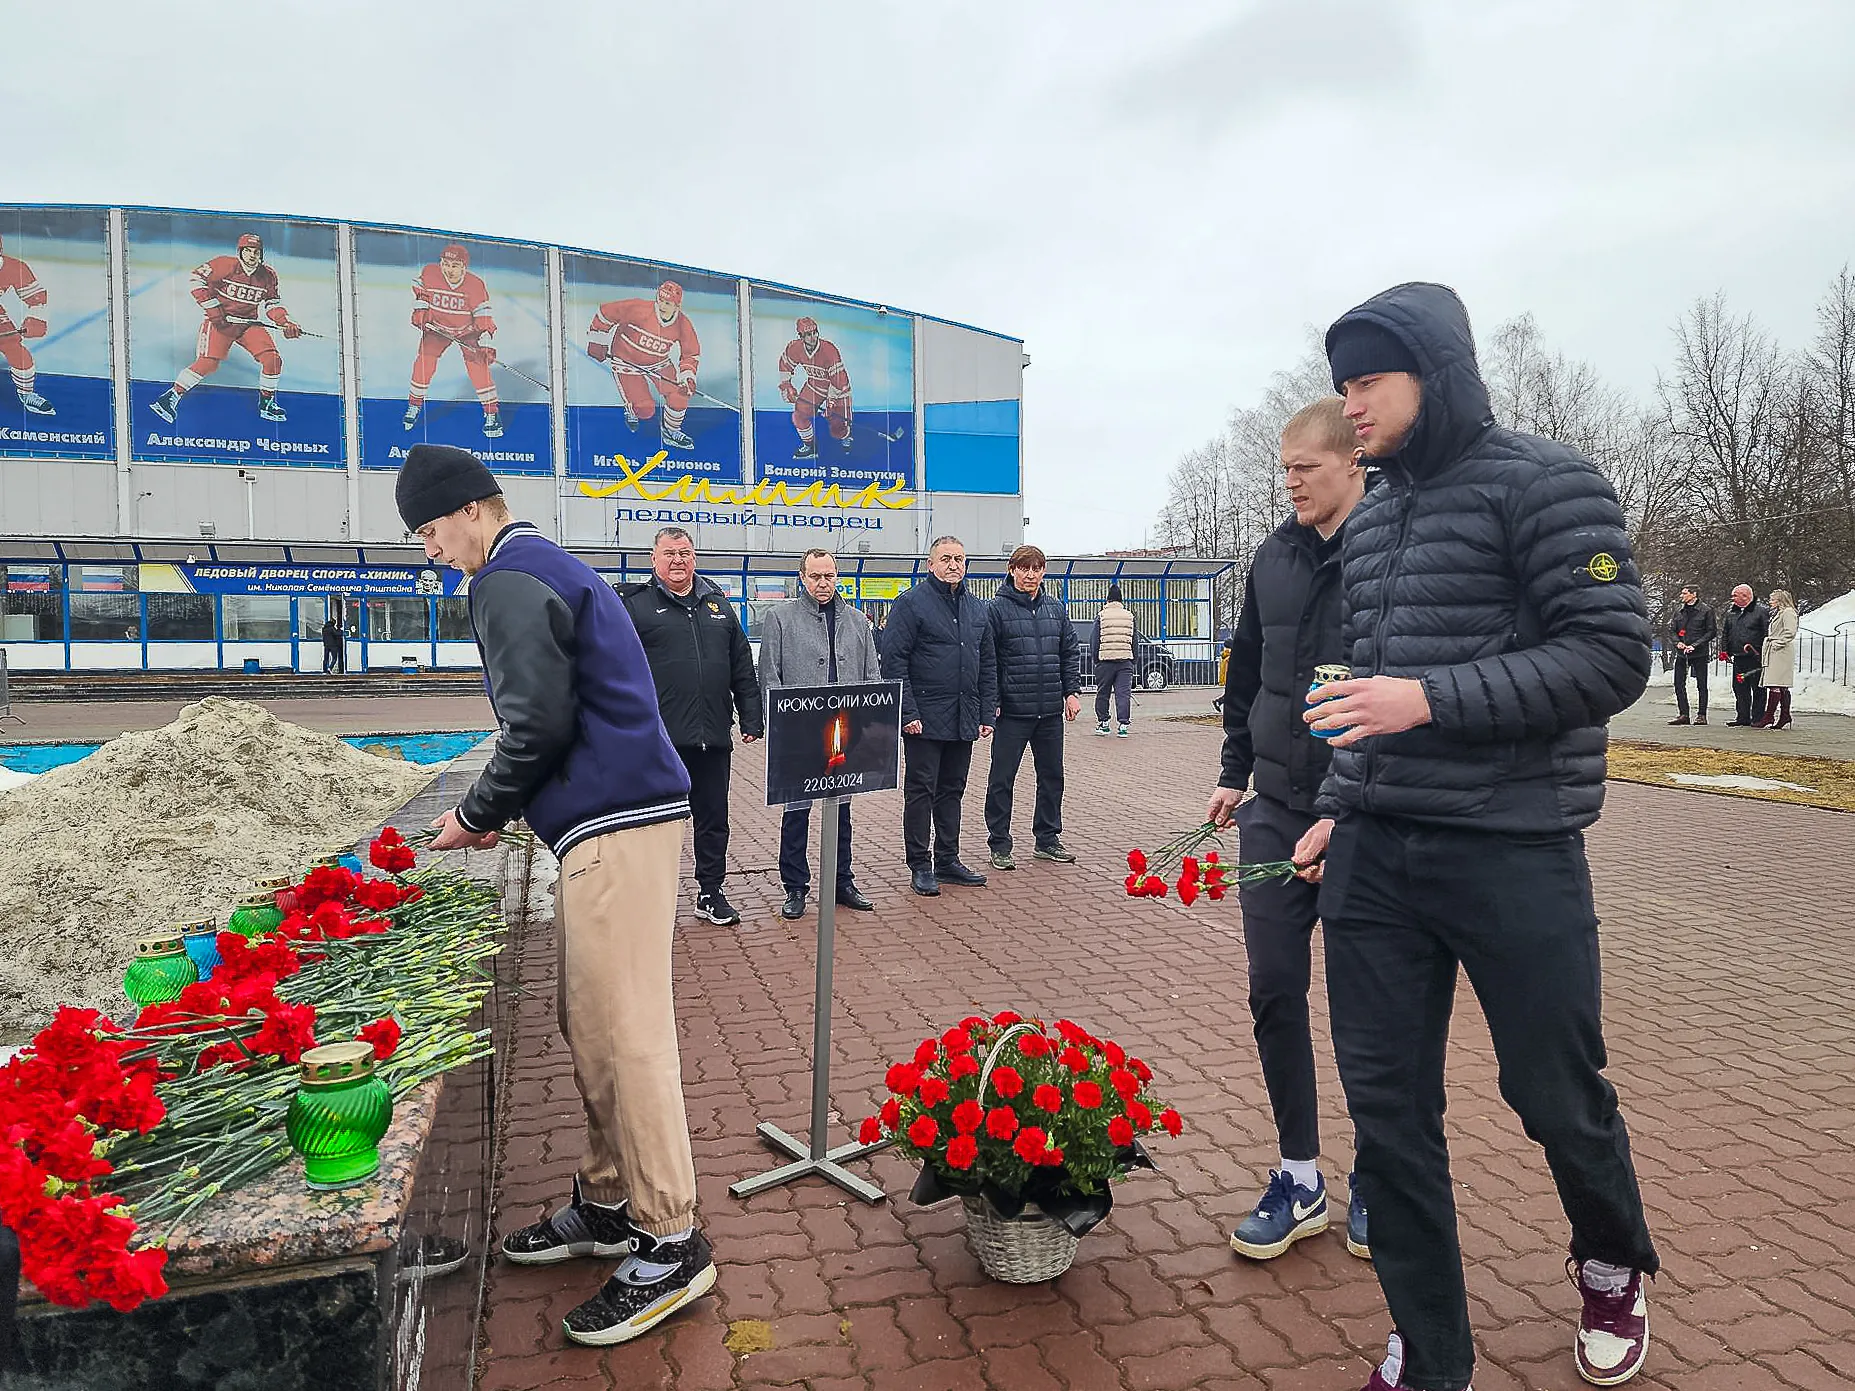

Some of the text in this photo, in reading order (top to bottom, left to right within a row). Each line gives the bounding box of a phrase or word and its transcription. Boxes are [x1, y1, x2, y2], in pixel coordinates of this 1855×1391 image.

[433, 293, 465, 310] СССР
[639, 334, 668, 353] СССР
[0, 427, 105, 444] Каменский
[147, 433, 329, 454] Александр Черных
[764, 463, 905, 480] Валерий Зелепукин
[615, 508, 883, 532] ледовый дворец
[194, 566, 414, 580] ЛЕДОВЫЙ ДВОРЕЦ СПОРТА «ХИМИК»
[265, 583, 305, 592] Николая
[364, 584, 413, 593] Эпштейна
[777, 692, 893, 713] КРОКУС СИТИ ХОЛЛ
[803, 773, 863, 792] 22.03.2024
